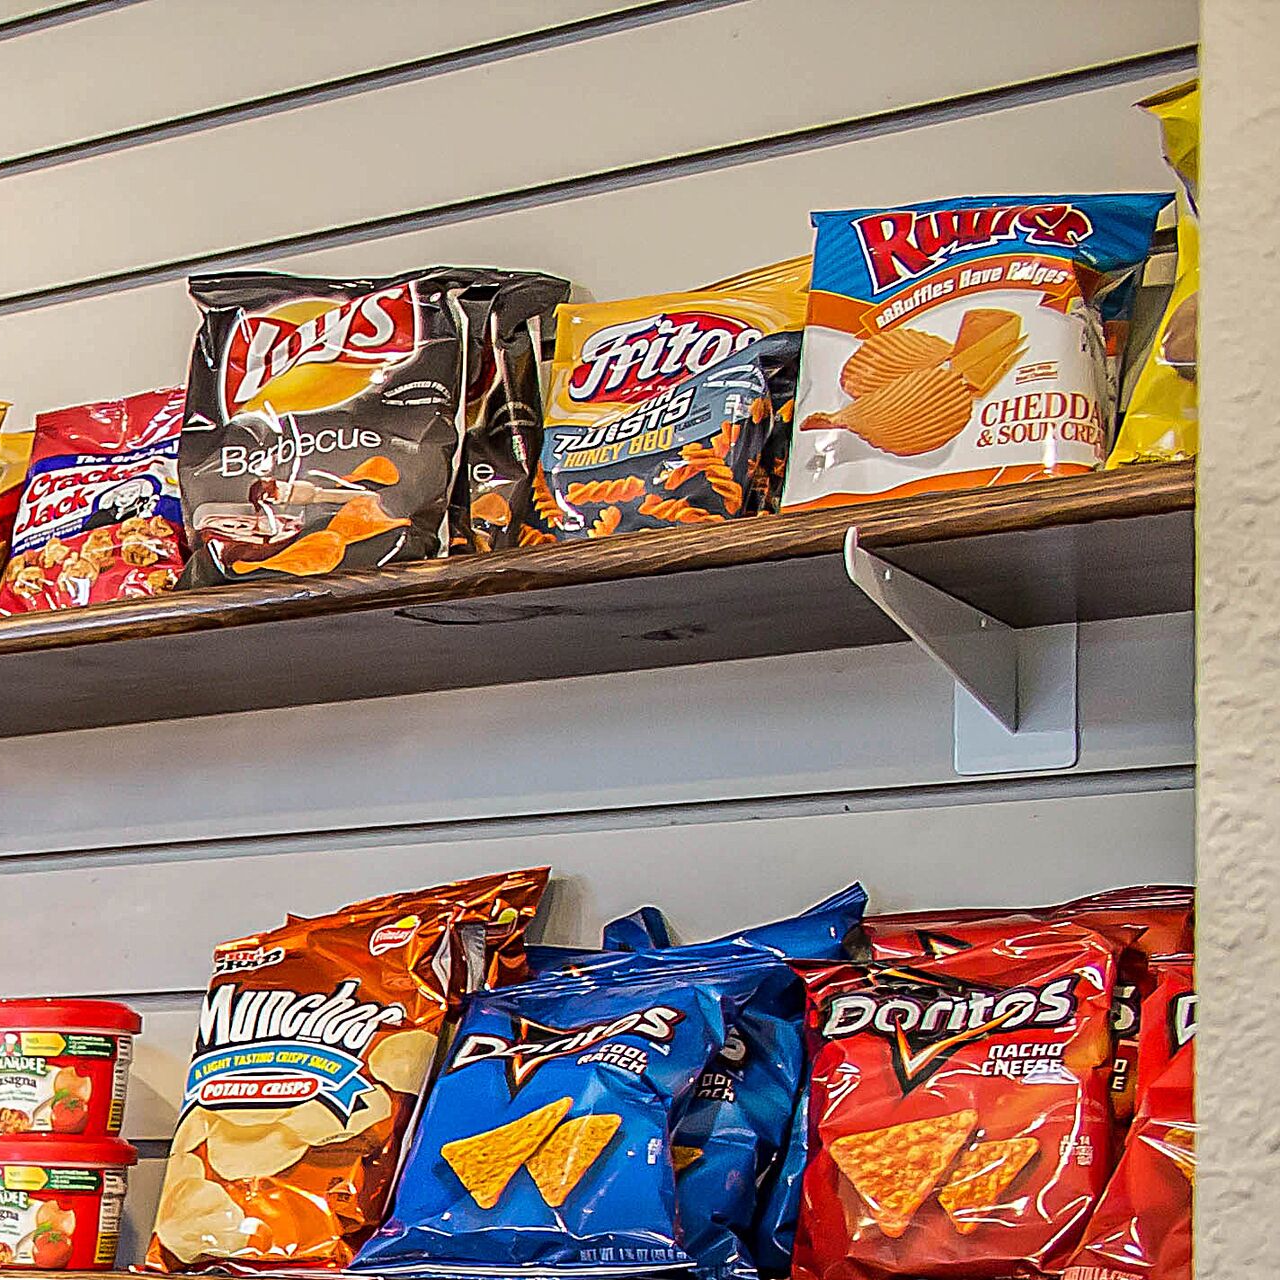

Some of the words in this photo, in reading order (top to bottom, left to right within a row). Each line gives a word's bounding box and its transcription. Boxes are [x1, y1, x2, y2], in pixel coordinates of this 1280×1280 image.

[959, 266, 1003, 290] Have
[569, 315, 764, 399] Fritos
[564, 443, 625, 467] HONEY
[628, 426, 674, 455] BBQ
[977, 430, 993, 447] &
[75, 455, 105, 465] The
[221, 426, 382, 477] Barbecue
[16, 490, 95, 534] Jack
[199, 979, 404, 1049] Munchos
[824, 979, 1074, 1037] Doritos
[453, 1005, 680, 1067] Doritos
[577, 1050, 648, 1075] RANCH
[598, 1043, 648, 1063] COOL
[988, 1043, 1064, 1059] NACHO
[203, 1058, 231, 1075] LIGHT
[234, 1052, 274, 1067] TASTING
[276, 1052, 309, 1065] CRISPY
[981, 1058, 1062, 1076] CHEESE
[203, 1083, 259, 1099] POTATO
[261, 1082, 313, 1095] CRISPS
